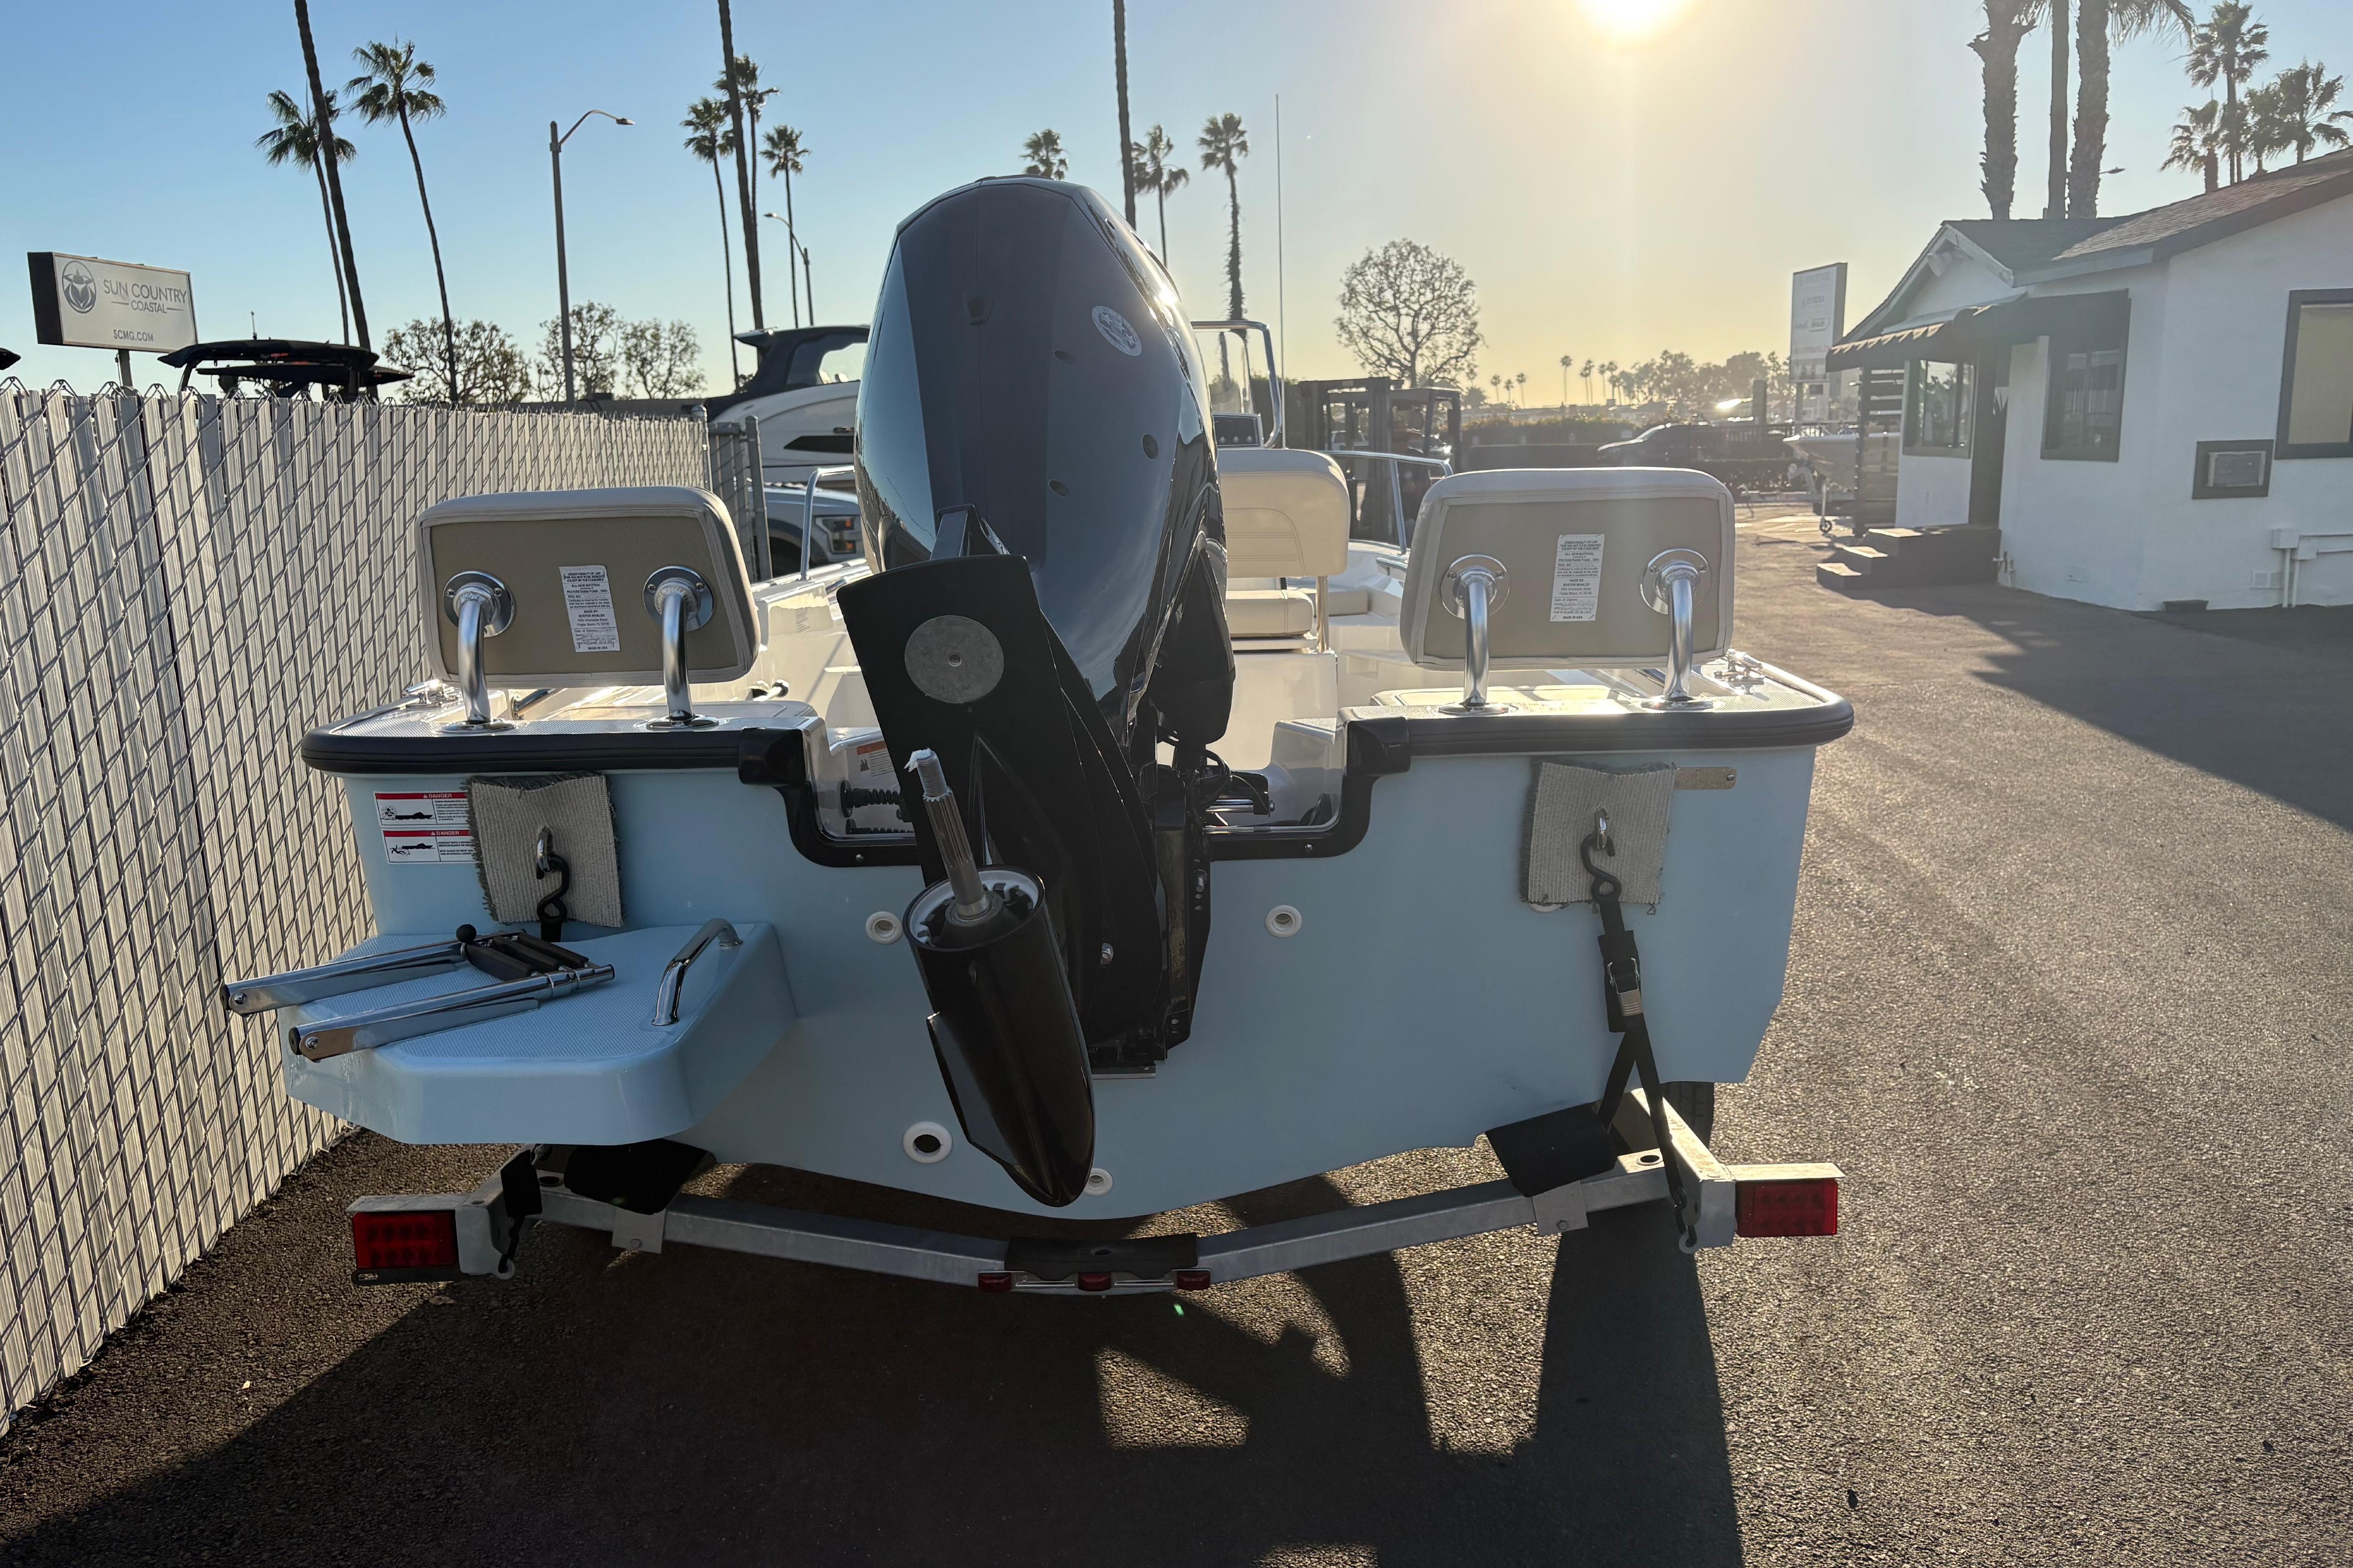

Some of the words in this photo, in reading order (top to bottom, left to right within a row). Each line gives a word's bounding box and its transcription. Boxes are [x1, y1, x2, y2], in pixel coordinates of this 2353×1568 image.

[103, 279, 129, 296] SUN
[131, 283, 187, 304] COUNTRY
[131, 299, 167, 314] COASTAL
[113, 329, 154, 342] SCMG.COM
